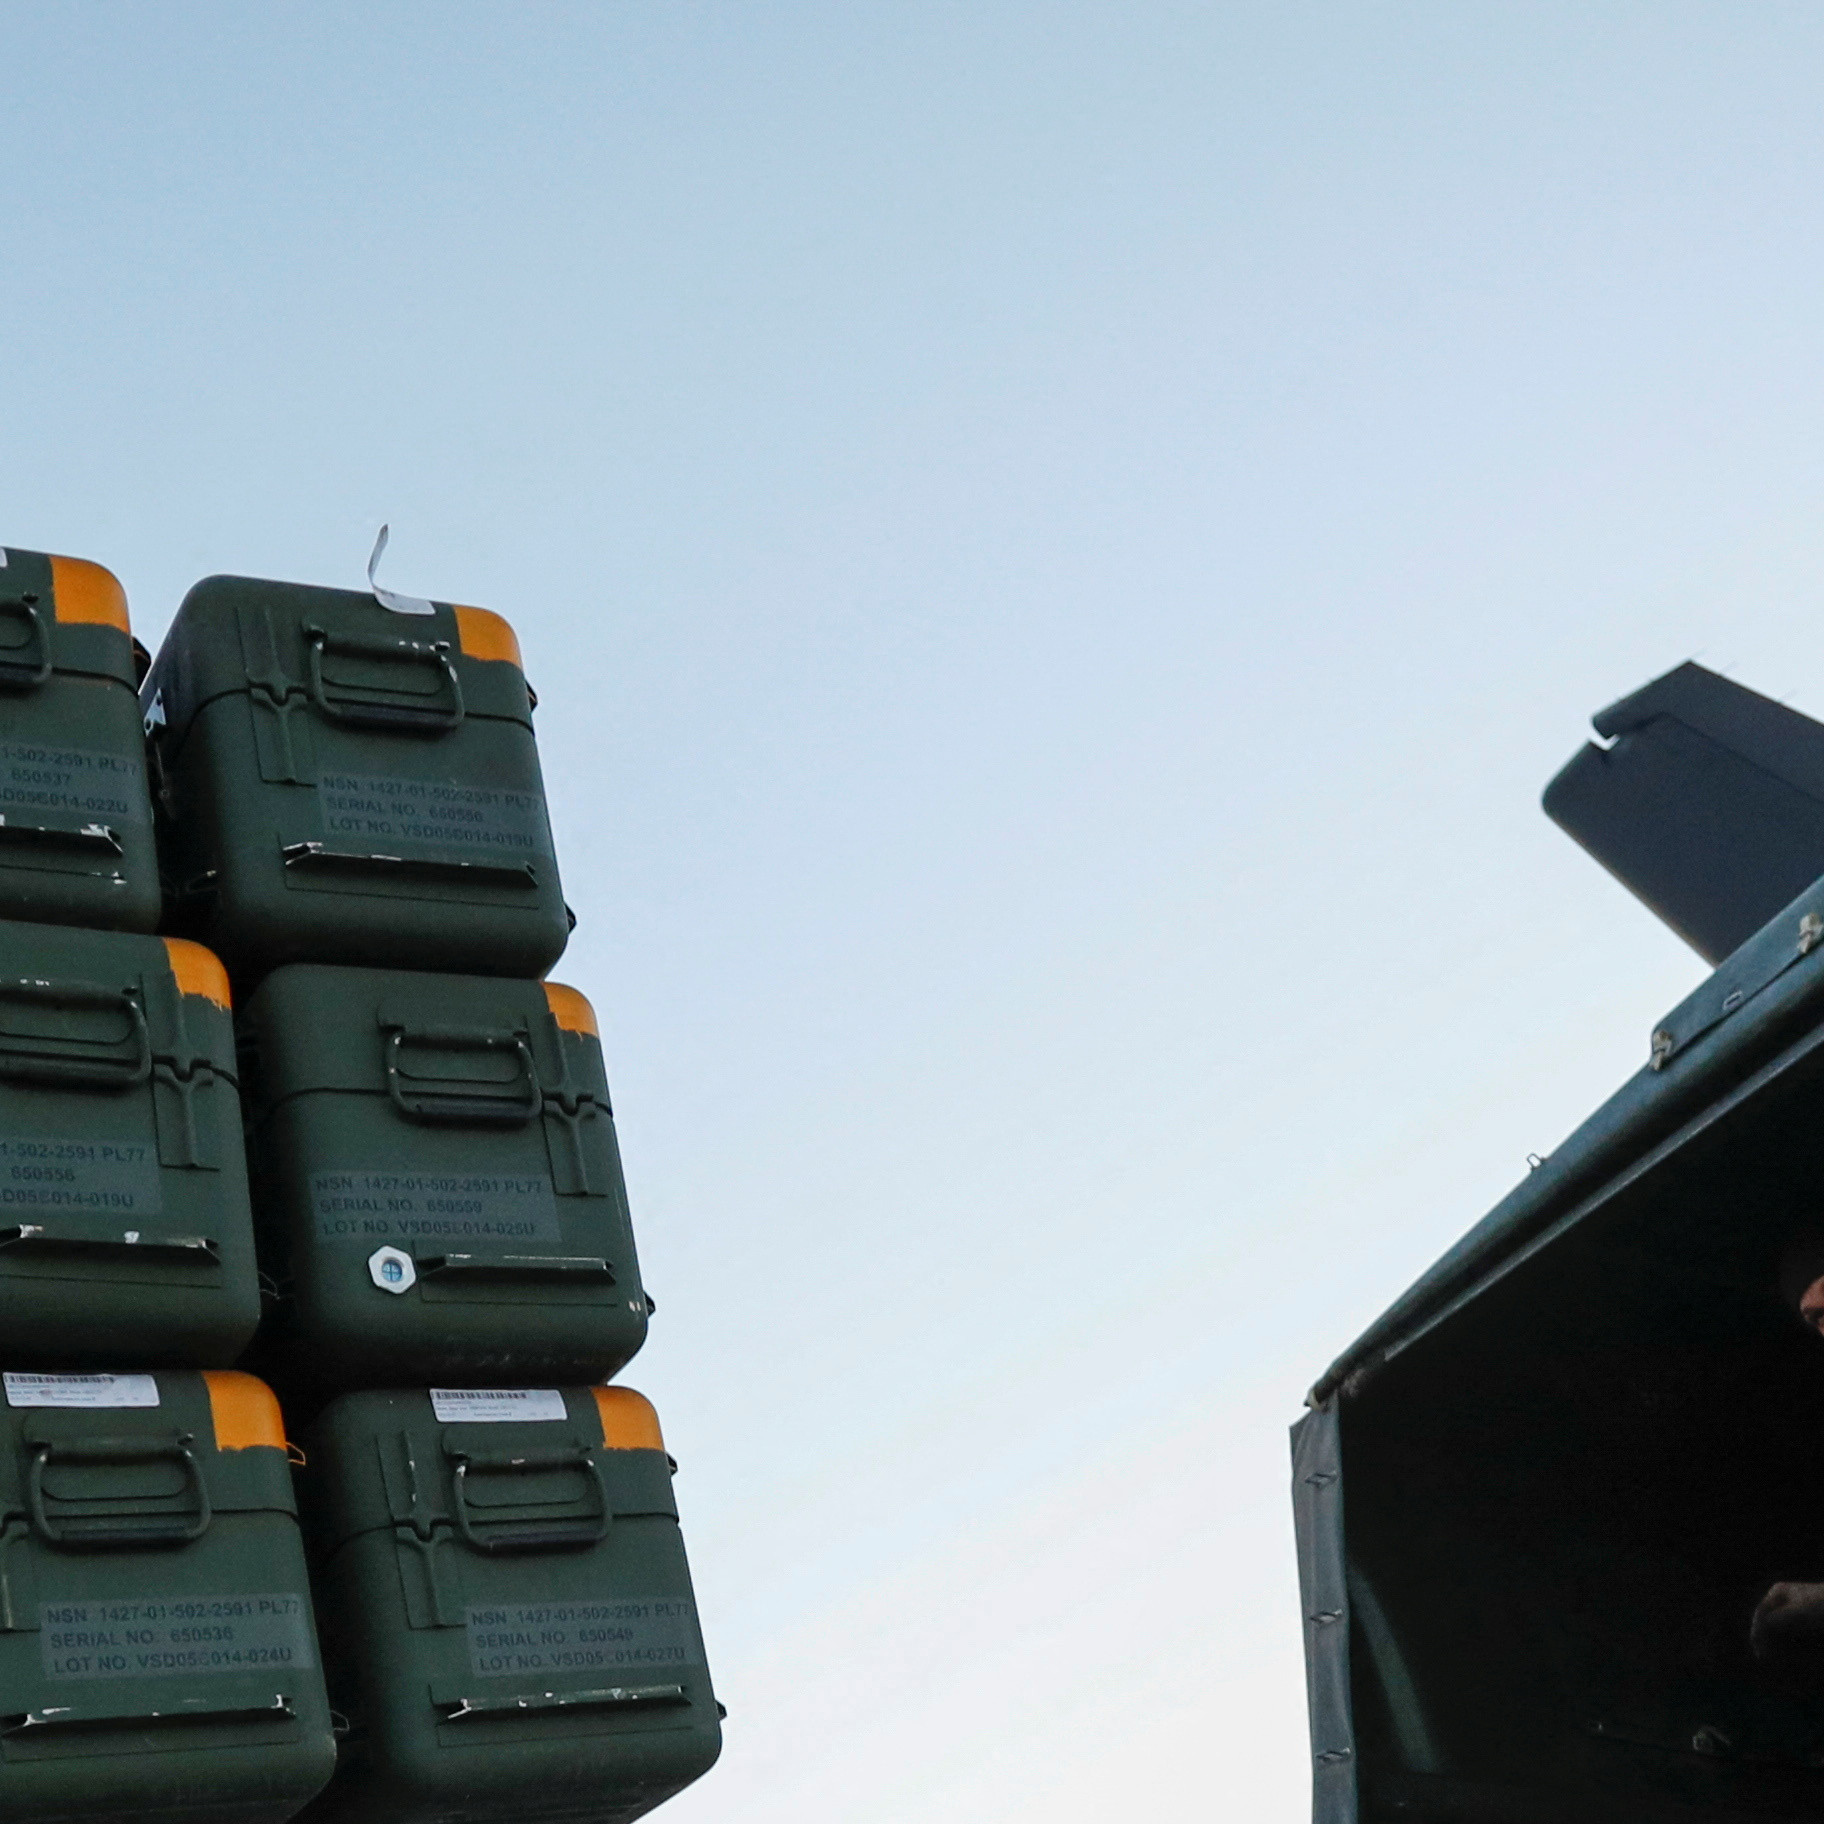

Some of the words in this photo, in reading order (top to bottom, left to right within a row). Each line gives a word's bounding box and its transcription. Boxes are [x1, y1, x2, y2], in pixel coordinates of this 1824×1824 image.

[327, 797, 383, 813] SERIAL
[330, 817, 361, 831] LOT
[315, 1177, 353, 1191] NSN
[320, 1199, 385, 1213] SERIAL
[324, 1220, 357, 1235] LOT
[47, 1608, 88, 1623] NSN
[472, 1611, 507, 1625] NSN
[50, 1631, 121, 1648] SERIAL
[476, 1633, 538, 1648] SERIAL
[54, 1658, 92, 1674] LOT
[480, 1657, 512, 1671] LOT
